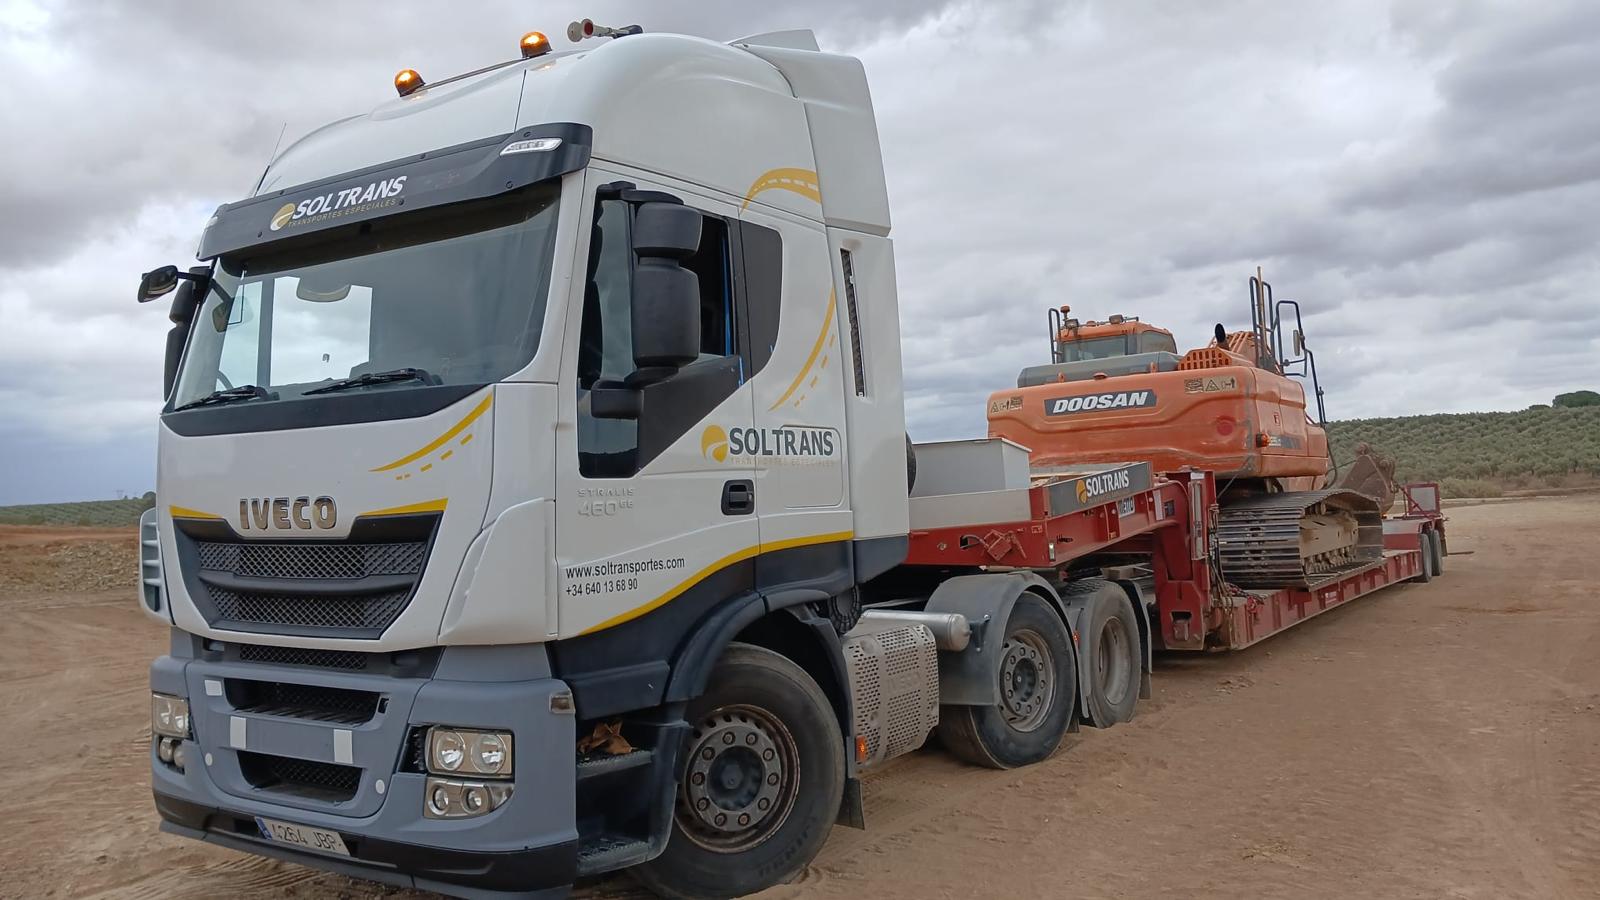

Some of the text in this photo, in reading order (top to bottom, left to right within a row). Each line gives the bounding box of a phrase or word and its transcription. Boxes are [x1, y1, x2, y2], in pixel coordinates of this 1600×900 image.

[292, 175, 407, 220] SOLTRANS
[288, 200, 396, 228] TRANSPORTES ESPECIALES
[1053, 391, 1148, 413] DOOSAN
[729, 427, 834, 456] SOLTRANS
[576, 487, 634, 498] STRALIS
[1086, 470, 1130, 497] SOLTRANS
[240, 496, 338, 530] IVECO
[566, 557, 685, 579] www.soltransportes.com
[566, 578, 638, 597] +34 640 13 68 90
